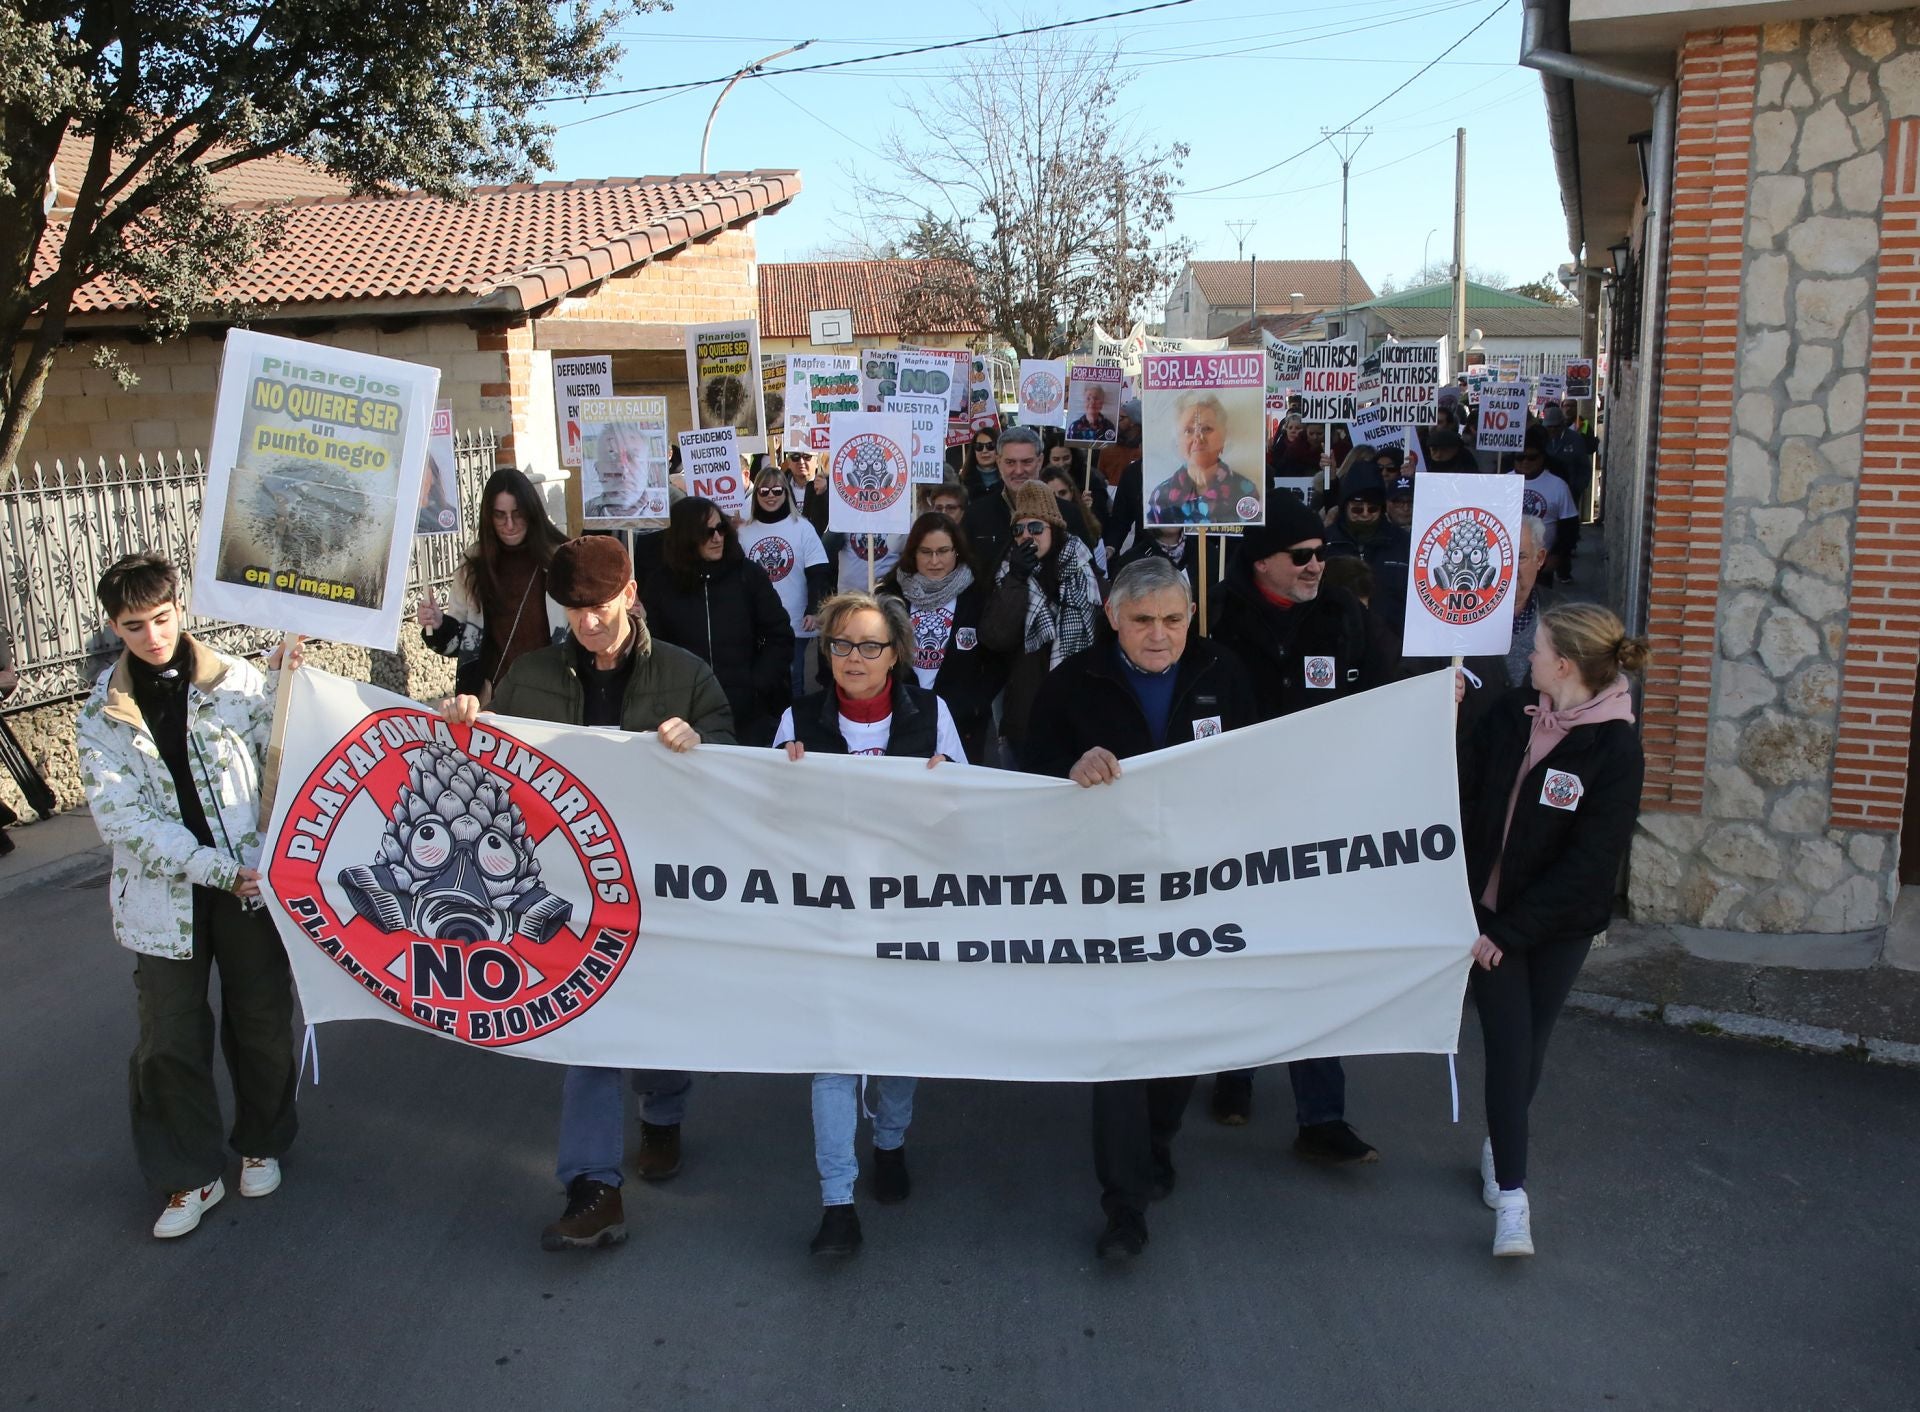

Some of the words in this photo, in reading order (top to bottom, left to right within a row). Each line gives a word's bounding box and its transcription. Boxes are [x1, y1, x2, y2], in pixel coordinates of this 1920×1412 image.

[698, 331, 746, 342] Pinarejos
[698, 344, 708, 358] NO
[709, 343, 734, 358] QUIERE
[734, 342, 748, 355] SER
[870, 351, 898, 360] Mapfre
[1382, 344, 1437, 363] INCOMPETENTE
[557, 362, 607, 377] DEFENDEMOS
[702, 364, 724, 376] punto
[725, 363, 747, 375] negro
[793, 358, 826, 370] Mapfre
[833, 359, 850, 369] IAM
[1148, 360, 1180, 380] POR
[1184, 359, 1204, 379] LA
[1207, 358, 1260, 379] SALUD
[1274, 362, 1284, 371] DE
[1567, 364, 1591, 378] NO
[262, 357, 401, 397] Pinarejos
[1072, 367, 1088, 377] POR
[1088, 368, 1099, 378] LA
[1098, 368, 1120, 379] SALUD
[1381, 365, 1438, 385] MENTIROSO
[899, 368, 951, 395] NO
[1178, 379, 1203, 388] planta
[1304, 371, 1357, 392] ALCALDE
[566, 384, 600, 397] NUESTRO
[1382, 386, 1435, 403] ALCALDE
[1483, 387, 1526, 397] NUESTRA
[255, 381, 284, 410] NO
[288, 387, 359, 424] QUIERE
[360, 400, 399, 431] SER
[583, 402, 606, 416] POR
[609, 403, 624, 415] LA
[625, 401, 661, 416] SALUD
[887, 402, 939, 414] NUESTRA
[1302, 393, 1357, 419] DIMISIÓN
[1380, 402, 1437, 423] DIMISIÓN
[1489, 401, 1520, 410] SALUD
[912, 421, 934, 431] LUD
[1483, 411, 1508, 430] NO
[312, 424, 335, 437] un
[680, 430, 732, 446] DEFENDEMOS
[1479, 433, 1523, 448] NEGOCIABLE
[257, 430, 319, 455] punto
[325, 442, 385, 468] negro
[690, 446, 727, 460] NUESTRO
[923, 445, 936, 454] ES
[693, 461, 731, 475] ENTORNO
[911, 461, 940, 479] CIABLE
[693, 476, 737, 496] NO
[859, 490, 881, 502] NO
[1418, 510, 1475, 568] PLATAFORMA
[1477, 513, 1512, 567] PINAREJOS
[245, 569, 271, 584] en
[275, 573, 296, 589] el
[300, 579, 356, 600] mapa
[1418, 580, 1444, 617] PLANTA
[1446, 611, 1459, 622] DE
[1462, 579, 1508, 623] BIOMETANO
[1448, 592, 1478, 611] NO
[918, 650, 940, 661] NO
[285, 715, 458, 863] PLATAFORMA
[467, 726, 630, 905] PINAREJOS
[654, 863, 728, 901] NO
[740, 868, 779, 904] A
[792, 872, 856, 910] LA
[869, 872, 1068, 909] PLANTA
[1081, 873, 1145, 905] DE
[1160, 823, 1457, 902] BIOMETANO
[957, 922, 1247, 964] PINAREJOS
[286, 895, 402, 1010] PLANTA
[411, 999, 459, 1036] DE
[468, 927, 632, 1042] BIOMETAN
[410, 941, 523, 1003] NO
